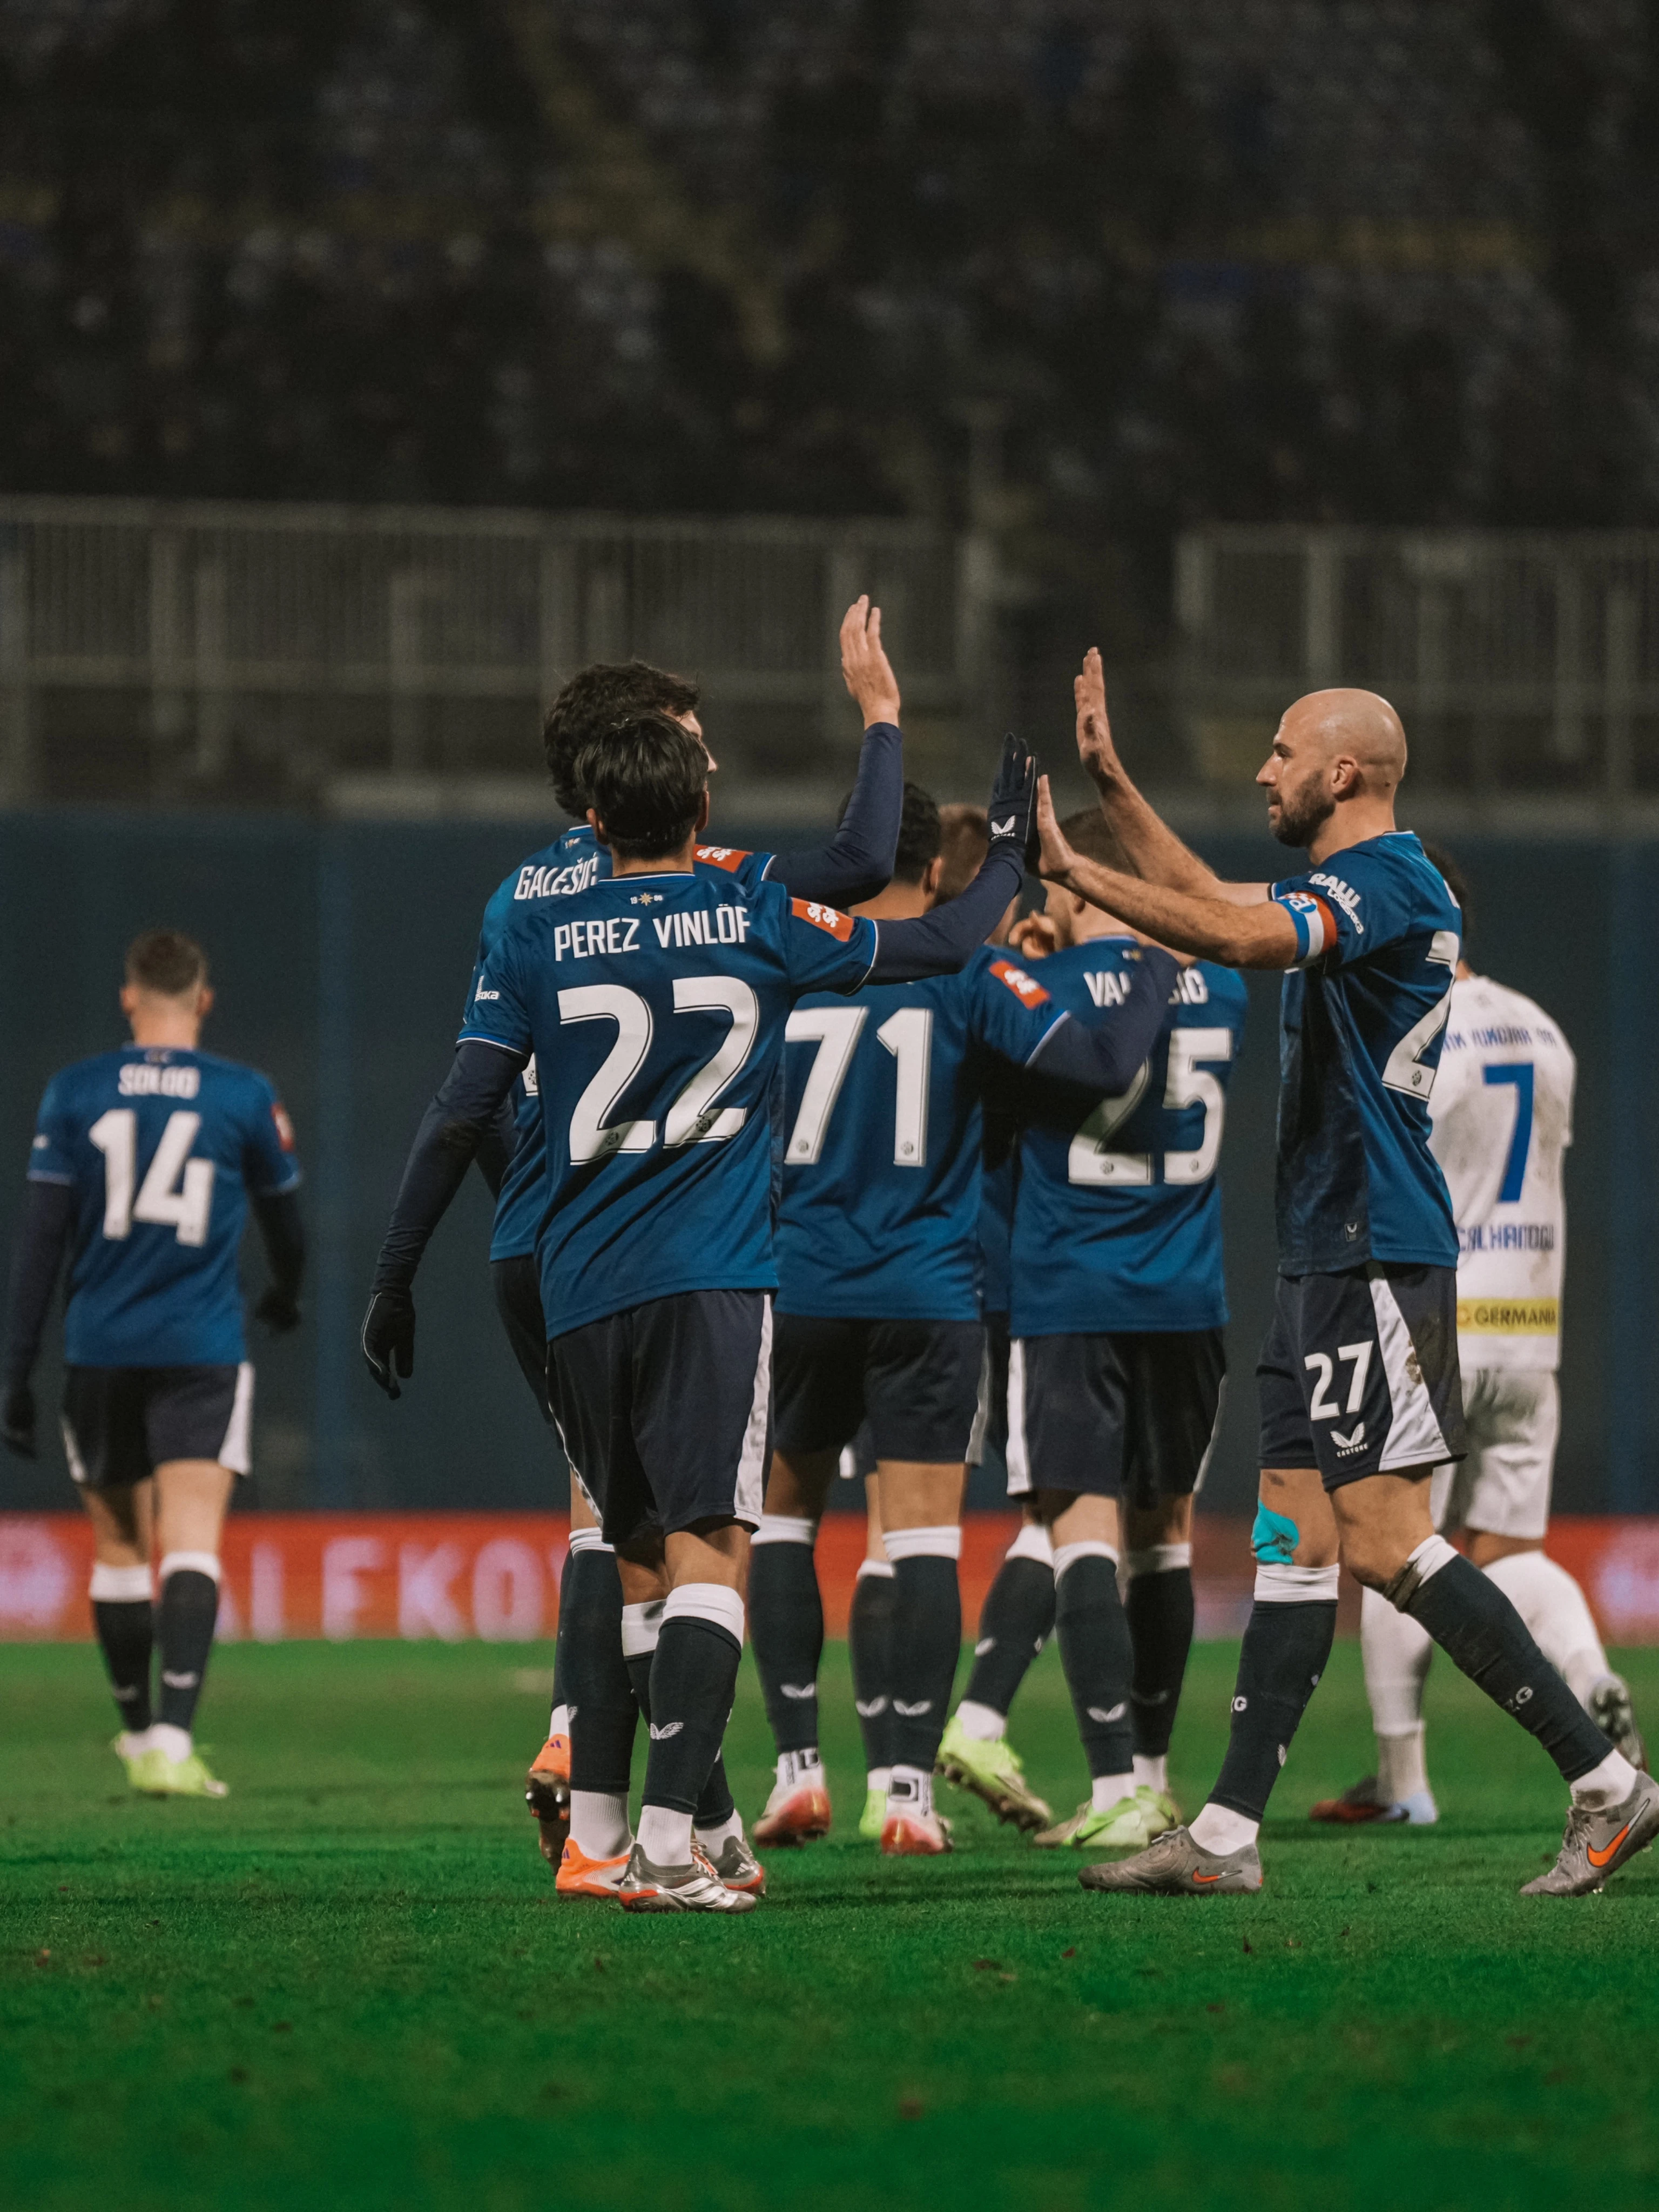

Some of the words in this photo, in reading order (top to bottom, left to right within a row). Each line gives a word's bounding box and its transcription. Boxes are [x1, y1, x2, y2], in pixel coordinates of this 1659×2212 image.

[514, 852, 599, 900] GALEŠIĆ
[554, 918, 640, 962] PEREZ
[652, 903, 751, 949] VINLÖF
[557, 975, 759, 1165] 22
[785, 1006, 933, 1167] 71
[89, 1108, 215, 1249] 14
[1482, 1063, 1534, 1204] 7
[1474, 1305, 1556, 1327] GERMANIA
[1304, 1340, 1373, 1421] 27
